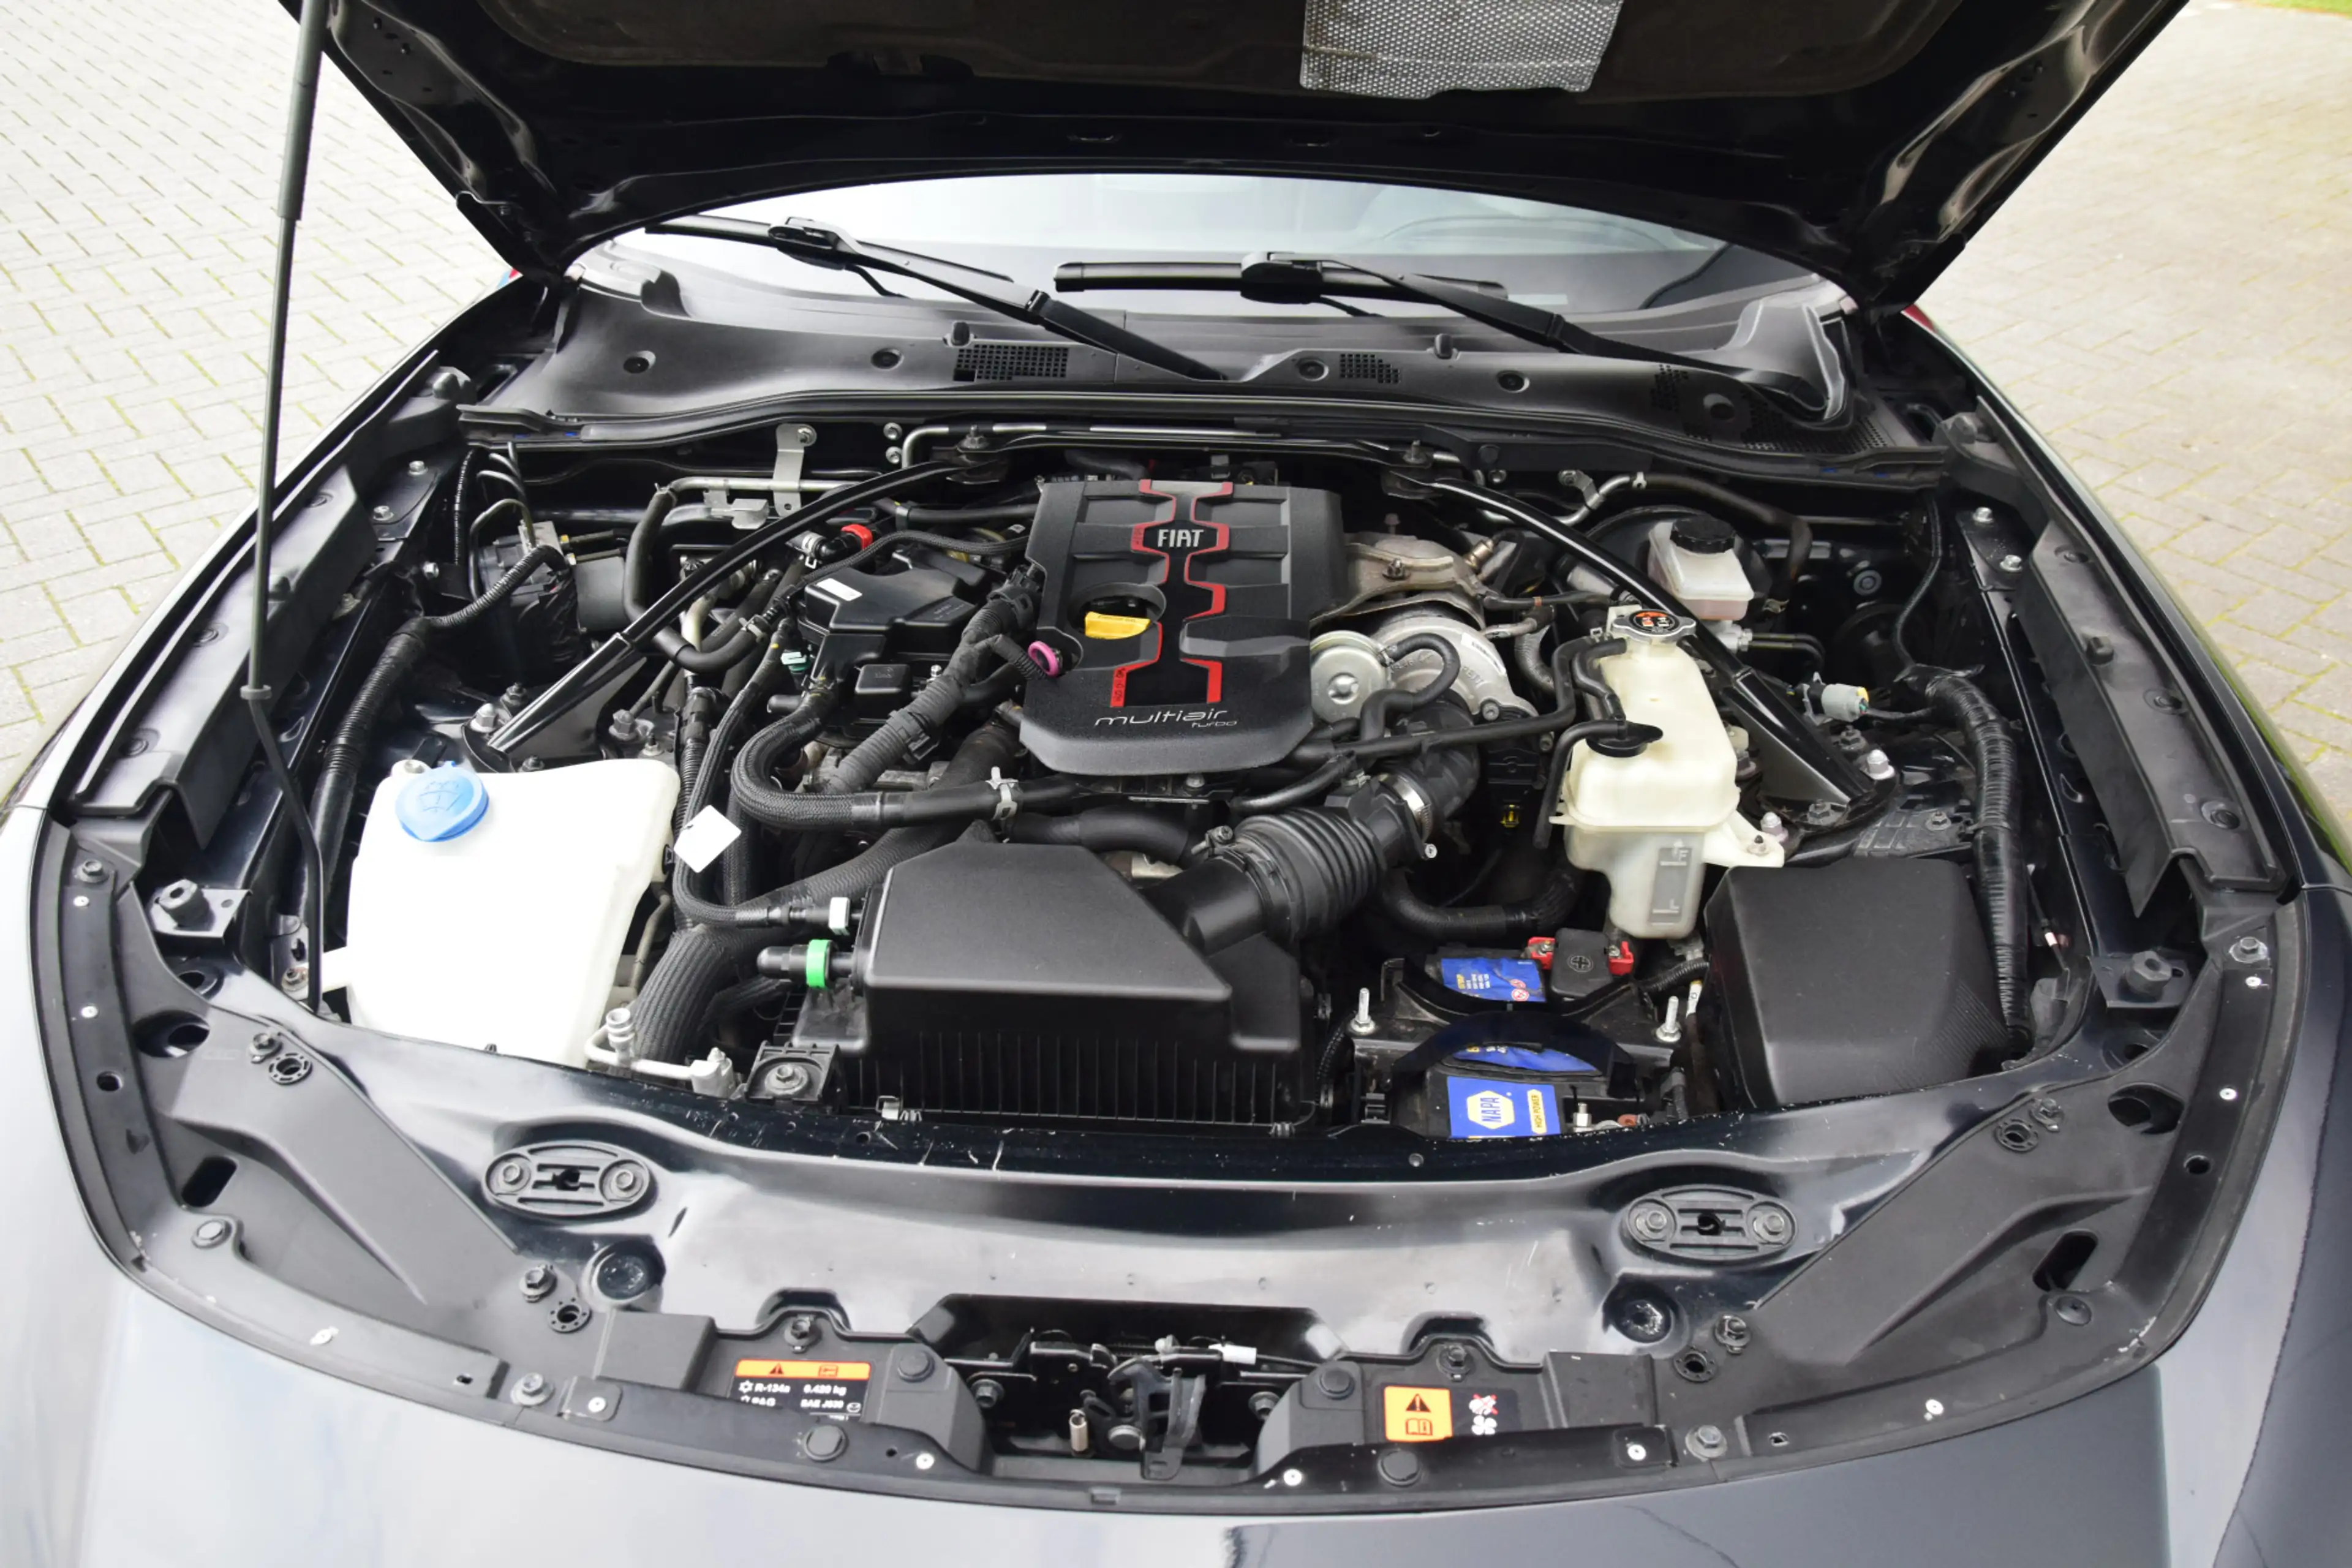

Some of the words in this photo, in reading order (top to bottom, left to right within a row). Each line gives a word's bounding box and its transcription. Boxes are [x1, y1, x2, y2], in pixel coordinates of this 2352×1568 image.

[1158, 529, 1204, 547] FIAT
[1094, 708, 1227, 727] multiair
[1480, 1097, 1501, 1123] NAPA
[1531, 1095, 1541, 1114] POWER
[1534, 1114, 1542, 1128] HIGH
